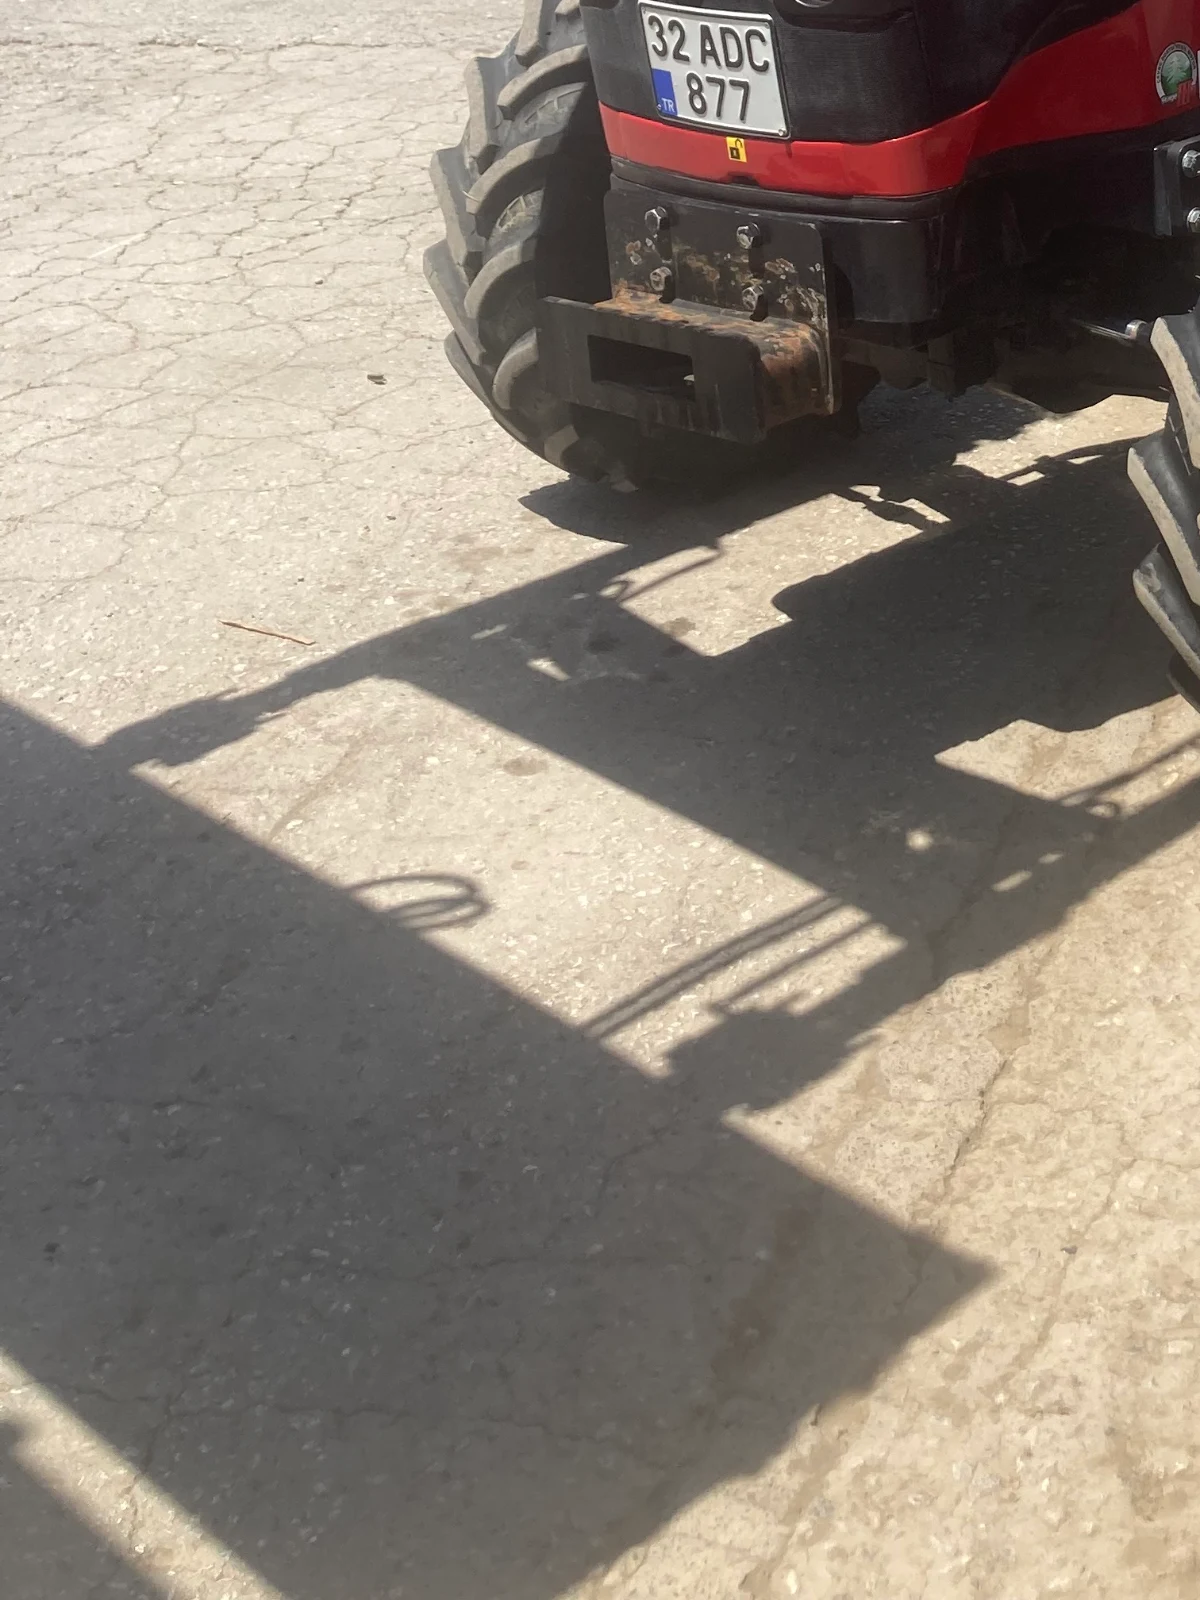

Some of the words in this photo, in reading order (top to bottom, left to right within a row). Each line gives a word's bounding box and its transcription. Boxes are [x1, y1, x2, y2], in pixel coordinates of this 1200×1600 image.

[648, 15, 691, 63] 32
[700, 24, 770, 73] ADC
[661, 98, 676, 113] TR
[686, 72, 750, 123] 877
